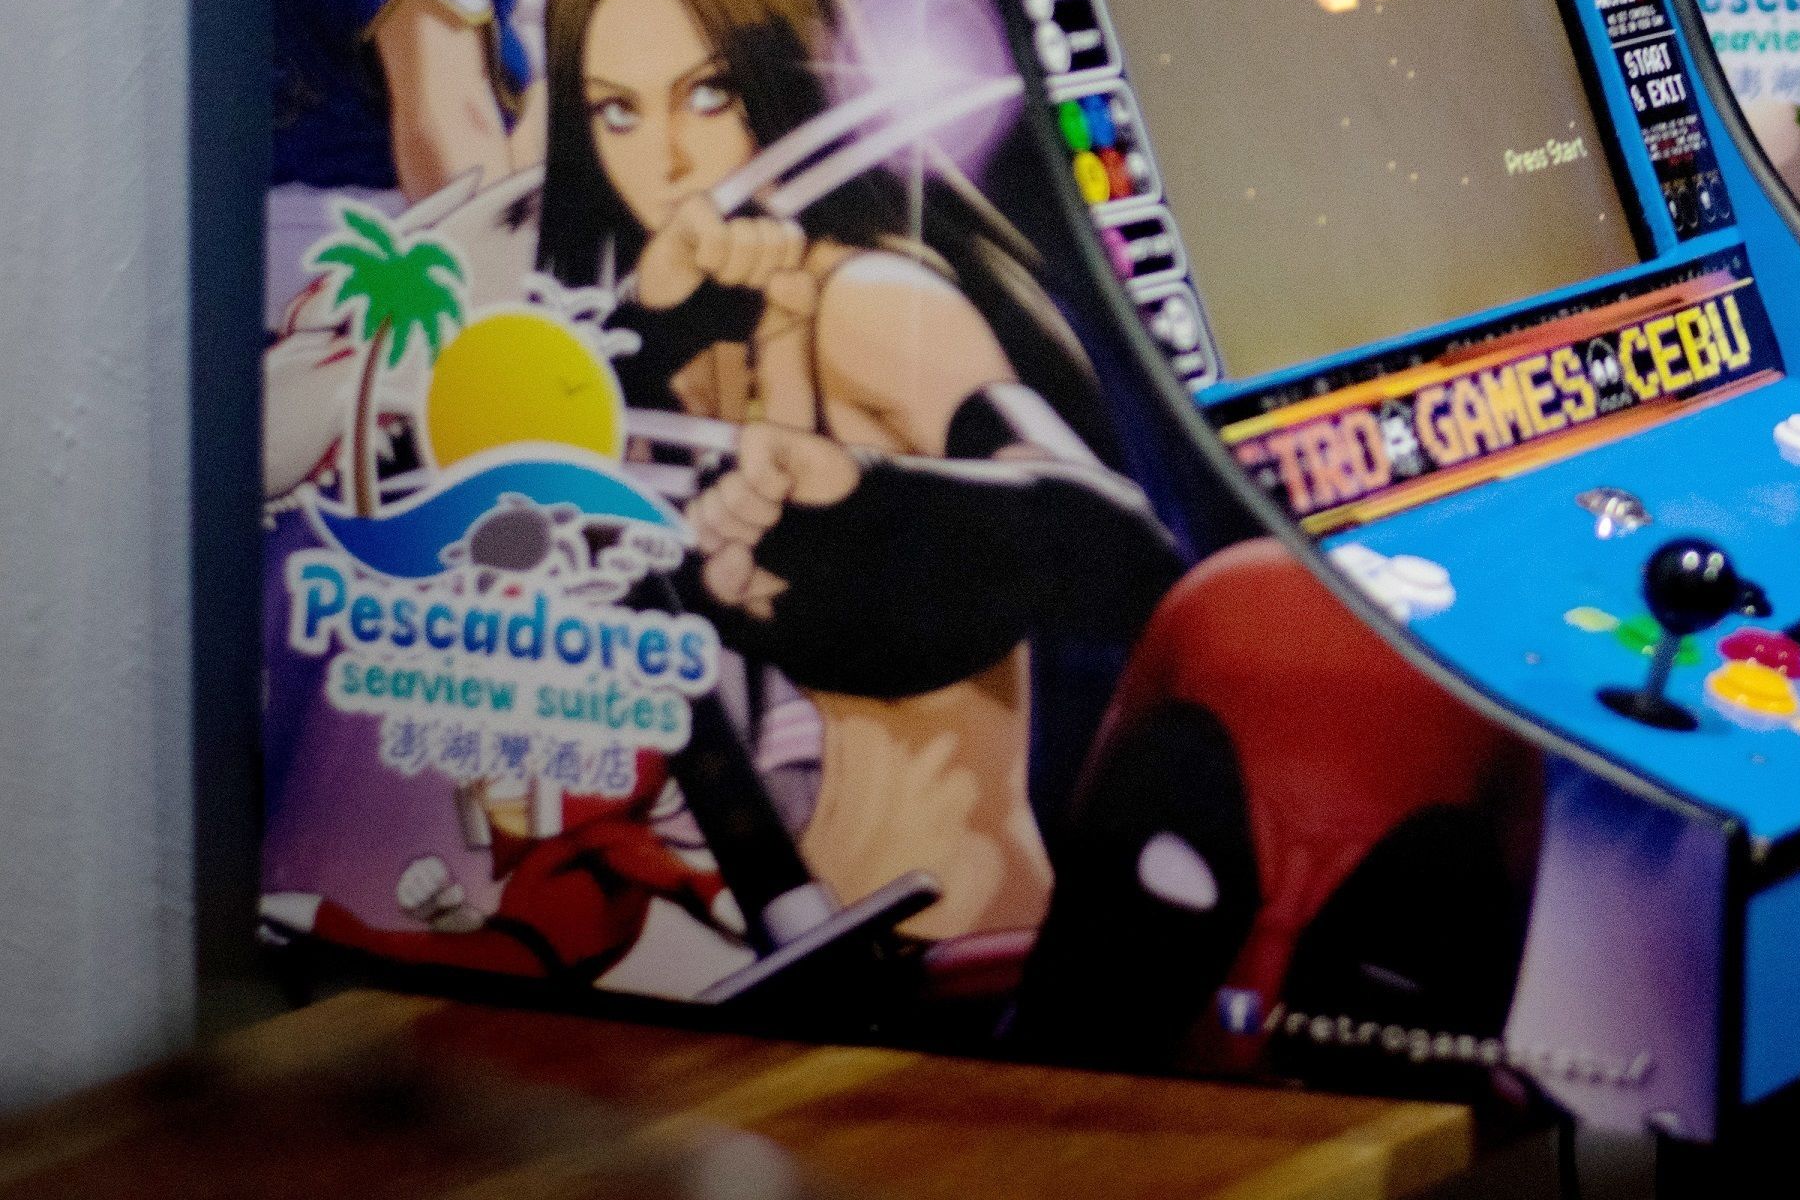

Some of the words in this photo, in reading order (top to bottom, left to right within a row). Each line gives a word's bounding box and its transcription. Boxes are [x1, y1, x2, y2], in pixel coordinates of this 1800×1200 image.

[1623, 42, 1672, 79] START
[1630, 83, 1647, 112] &
[1646, 73, 1687, 109] EXIT
[1504, 147, 1549, 176] Press
[1546, 137, 1589, 167] Start
[1252, 411, 1391, 514] TRO
[1415, 348, 1598, 466] GAMES
[1616, 294, 1752, 400] CEBU
[301, 564, 705, 681] Pescadores
[341, 656, 516, 712] seaview
[536, 673, 680, 733] suites
